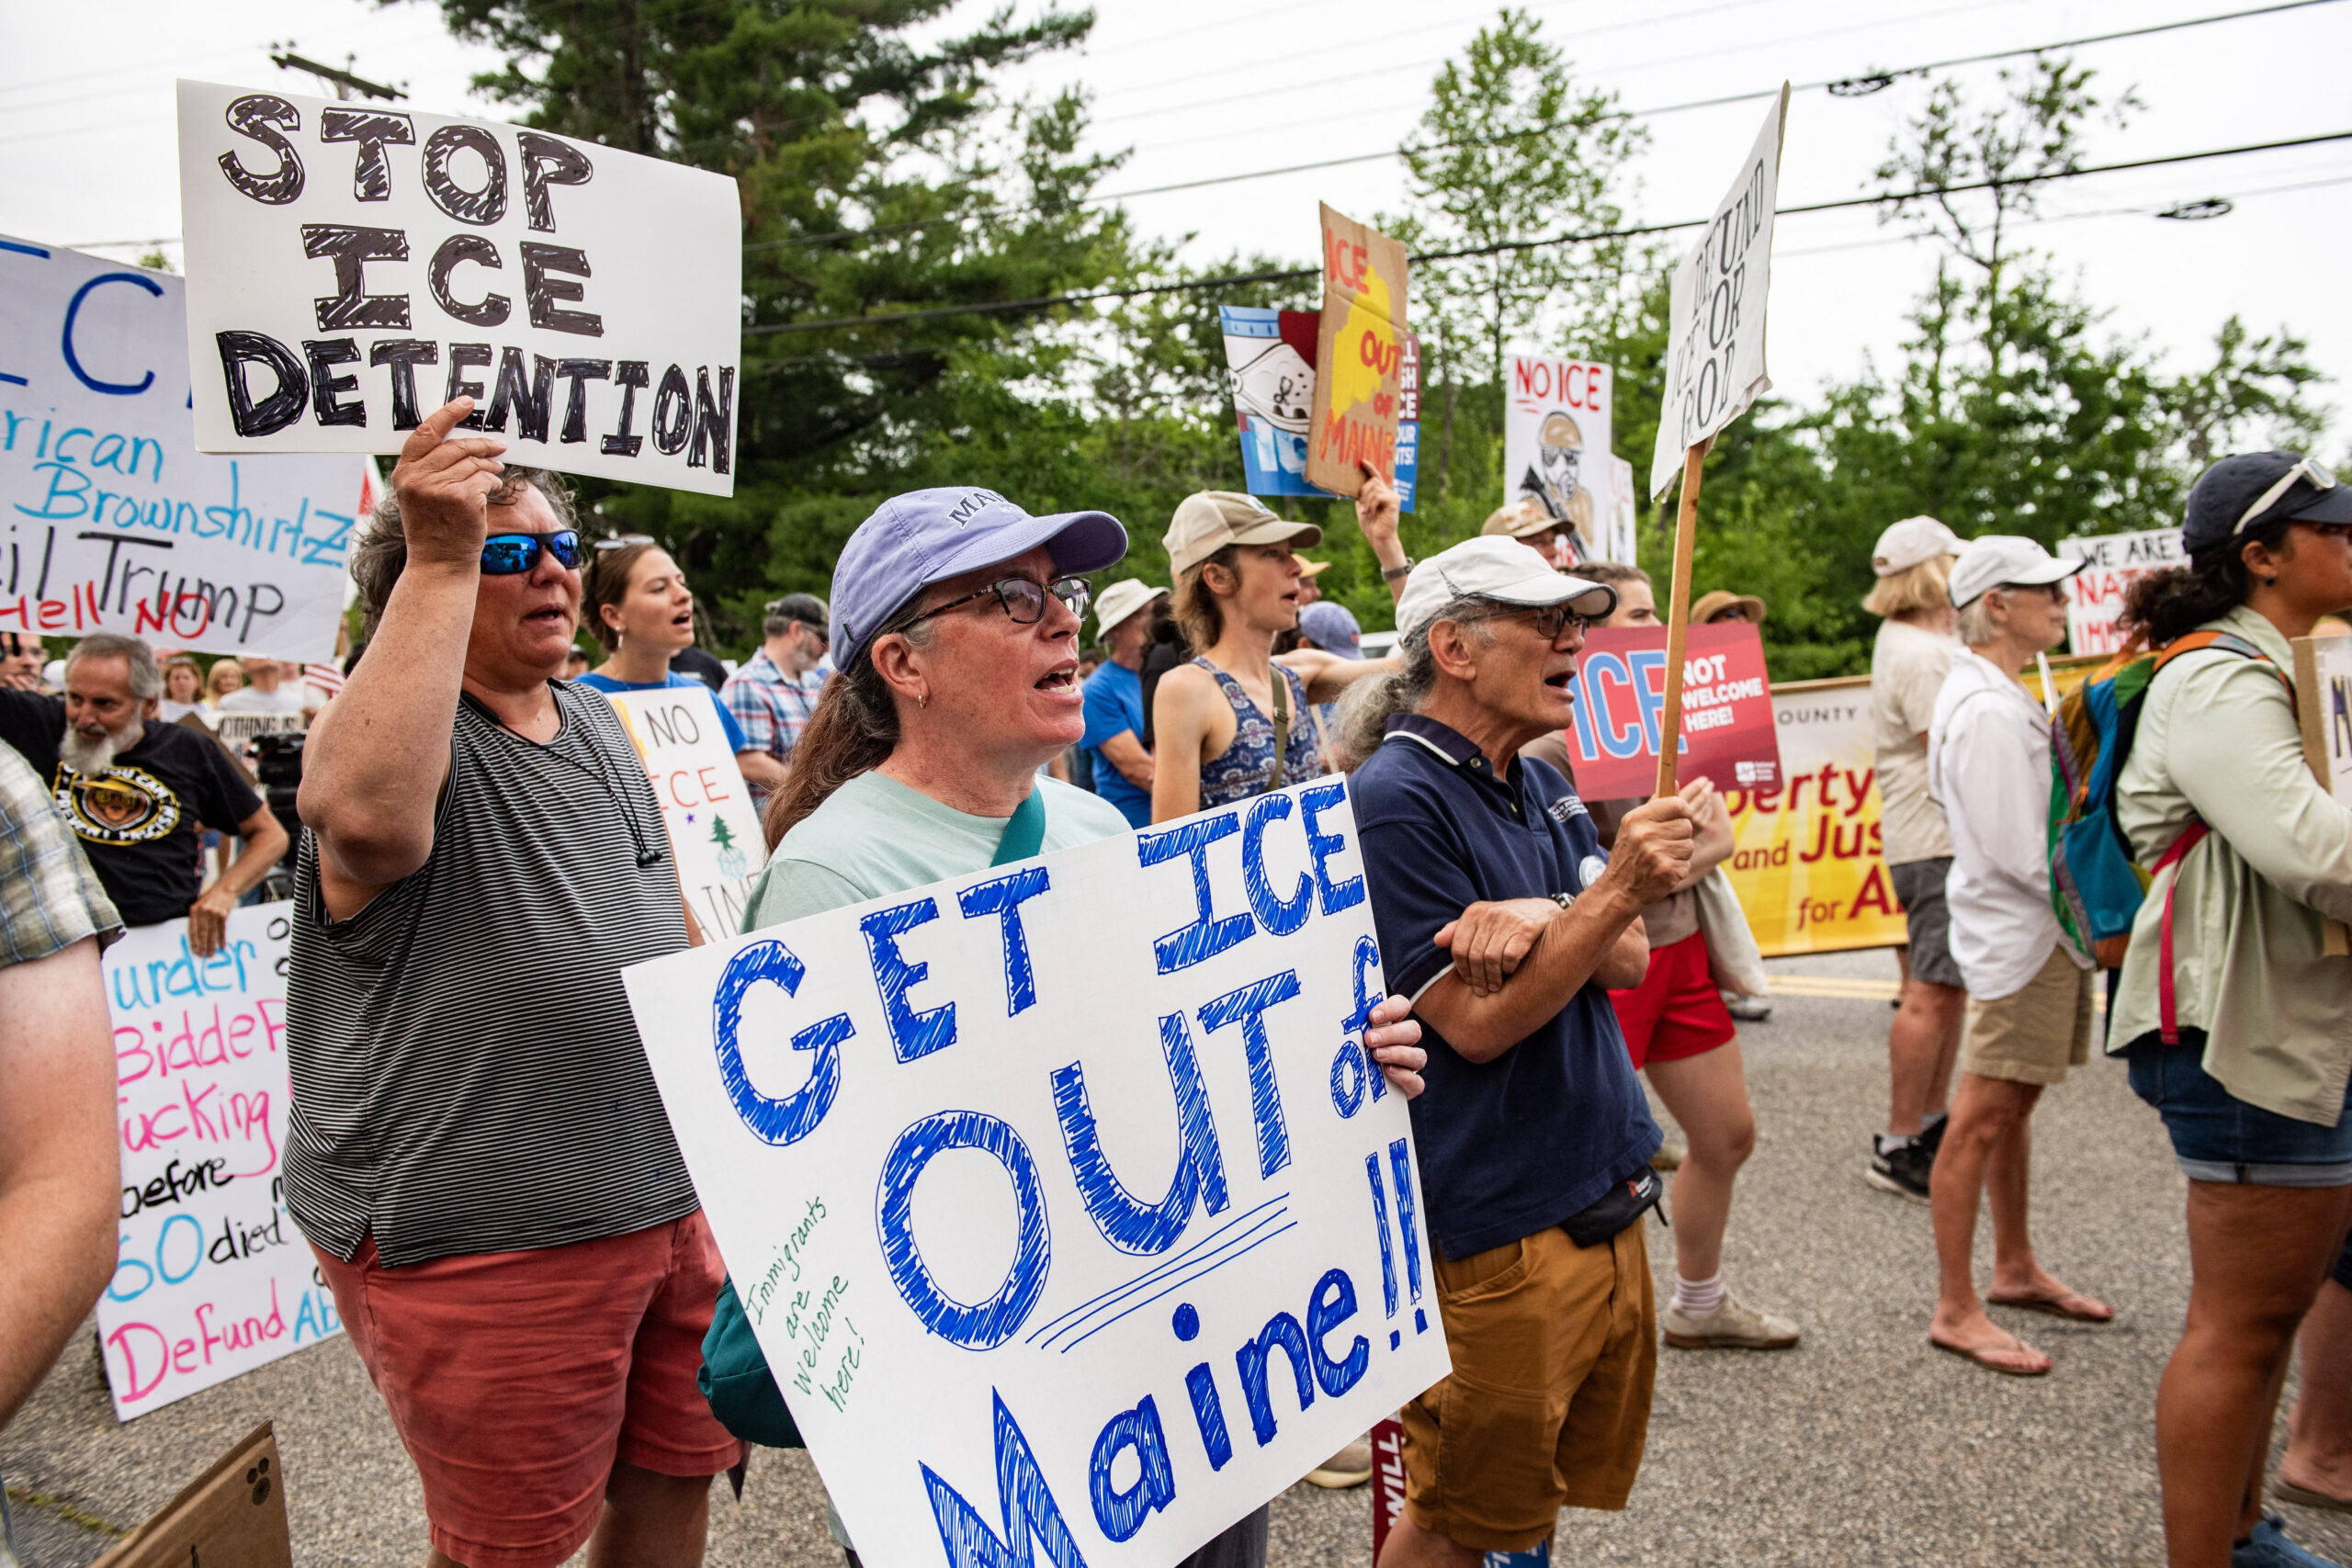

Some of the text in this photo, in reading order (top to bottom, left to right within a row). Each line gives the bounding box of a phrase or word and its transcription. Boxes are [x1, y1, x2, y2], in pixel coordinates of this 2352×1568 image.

[218, 94, 594, 233] STOP
[300, 223, 604, 338] ICE
[1327, 229, 1370, 295] ICE
[1702, 261, 1745, 352] OR
[1361, 330, 1404, 381] OUT
[1516, 357, 1602, 412] NO ICE
[215, 329, 735, 476] DETENTION
[1373, 392, 1394, 420] OF
[0, 408, 164, 483] rican
[1319, 408, 1394, 484] MAINE
[948, 491, 1007, 528] MAI
[0, 524, 284, 644] il Trump
[2077, 540, 2114, 567] WE
[2125, 532, 2173, 563] ARE
[134, 590, 210, 640] NO
[217, 716, 277, 737] OTHING
[645, 705, 700, 749] NO
[1569, 649, 1727, 762] ICE NOT
[1680, 677, 1764, 709] WELCOME
[1684, 705, 1736, 734] HERE!
[1777, 706, 1859, 726] OUNTY
[1734, 814, 1883, 871] and Jus
[1796, 863, 1907, 931] for A
[112, 933, 256, 1010] urder
[712, 782, 1366, 1146] GET ICE
[113, 998, 287, 1088] BiddeF
[117, 1078, 277, 1179] ucking
[875, 933, 1387, 1352] OUT of
[208, 1205, 290, 1264] died
[743, 1196, 827, 1325] Immigrants
[107, 1276, 341, 1404] Defund Ab
[786, 1290, 810, 1340] are
[793, 1274, 849, 1396] welcome
[918, 1137, 1429, 1568] Maine!!
[820, 1316, 865, 1413] here!
[1378, 1431, 1406, 1528] WILL
